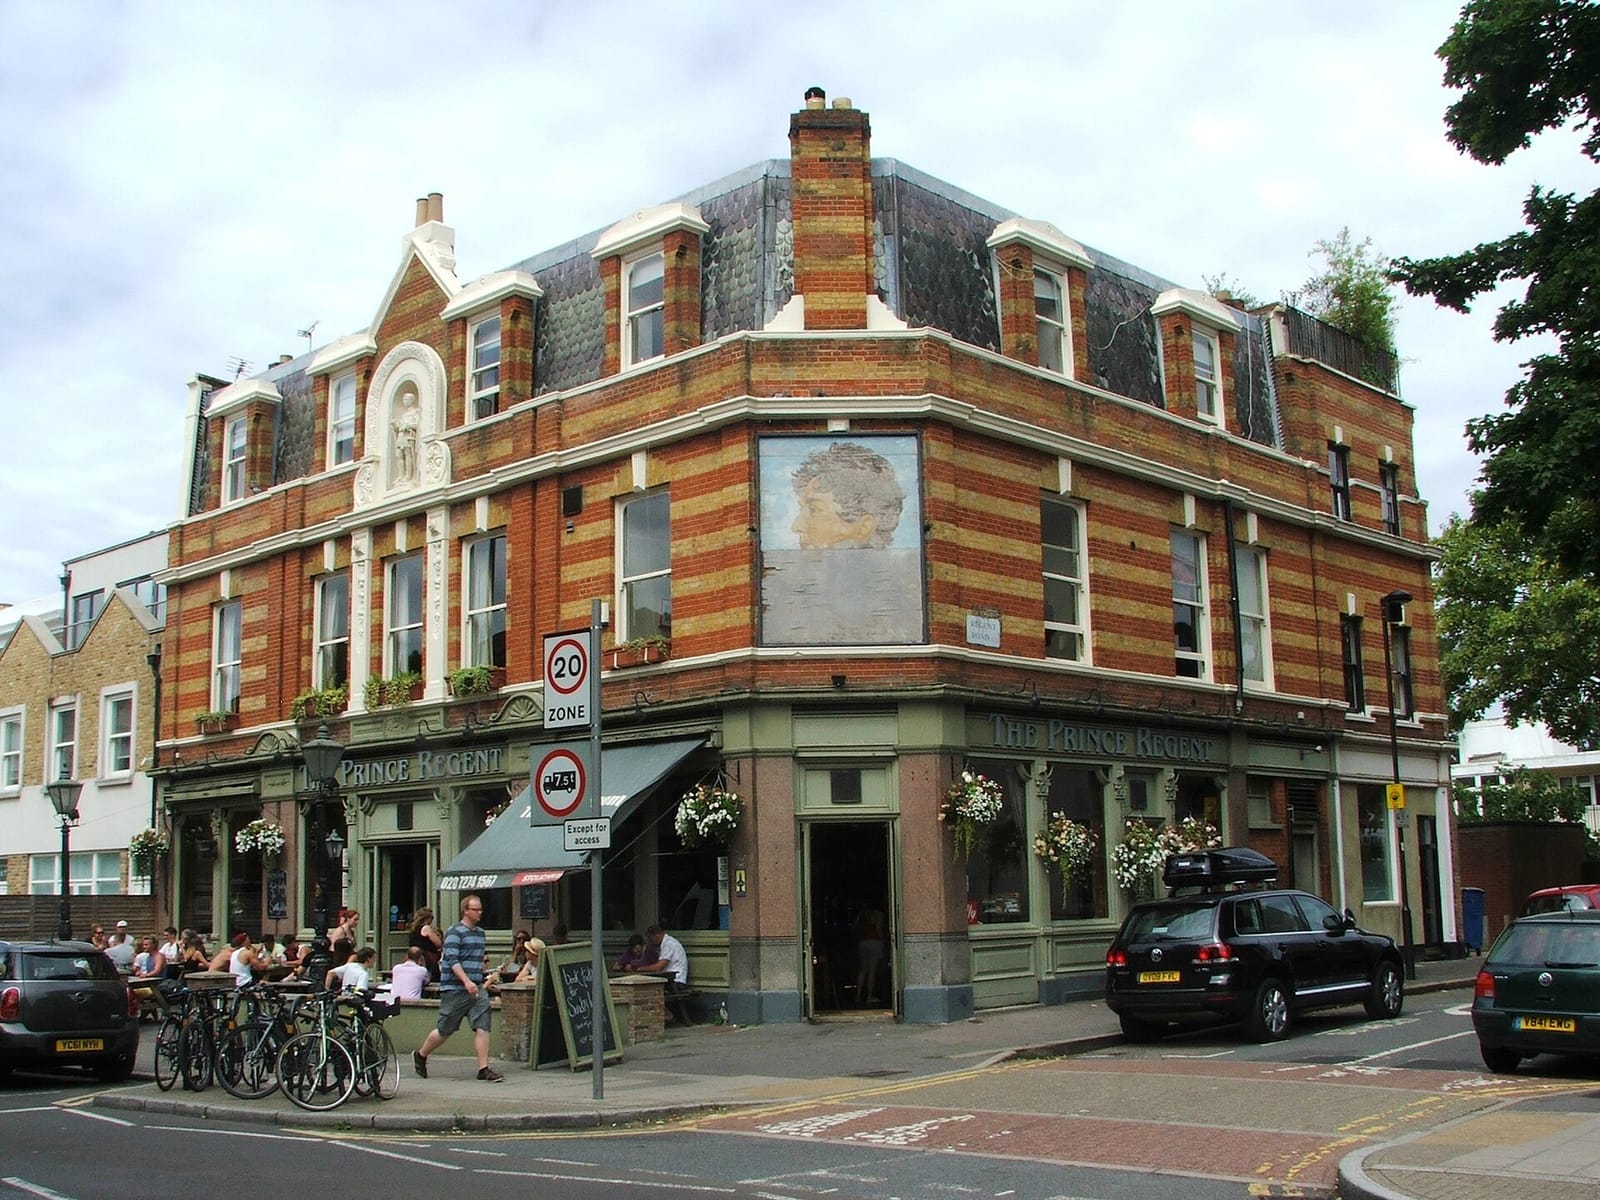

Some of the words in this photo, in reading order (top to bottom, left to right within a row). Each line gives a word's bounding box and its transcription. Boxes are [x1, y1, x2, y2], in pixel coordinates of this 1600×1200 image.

[554, 654, 581, 678] 20
[549, 705, 585, 722] ZONE
[989, 713, 1038, 748] THE
[1048, 719, 1127, 755] PRINCE
[1135, 727, 1213, 761] REGENT
[341, 759, 410, 787] PRINCE
[416, 748, 504, 779] REGENT
[567, 824, 594, 834] Except
[595, 823, 607, 832] for
[574, 836, 600, 845] access
[440, 876, 459, 890] 020
